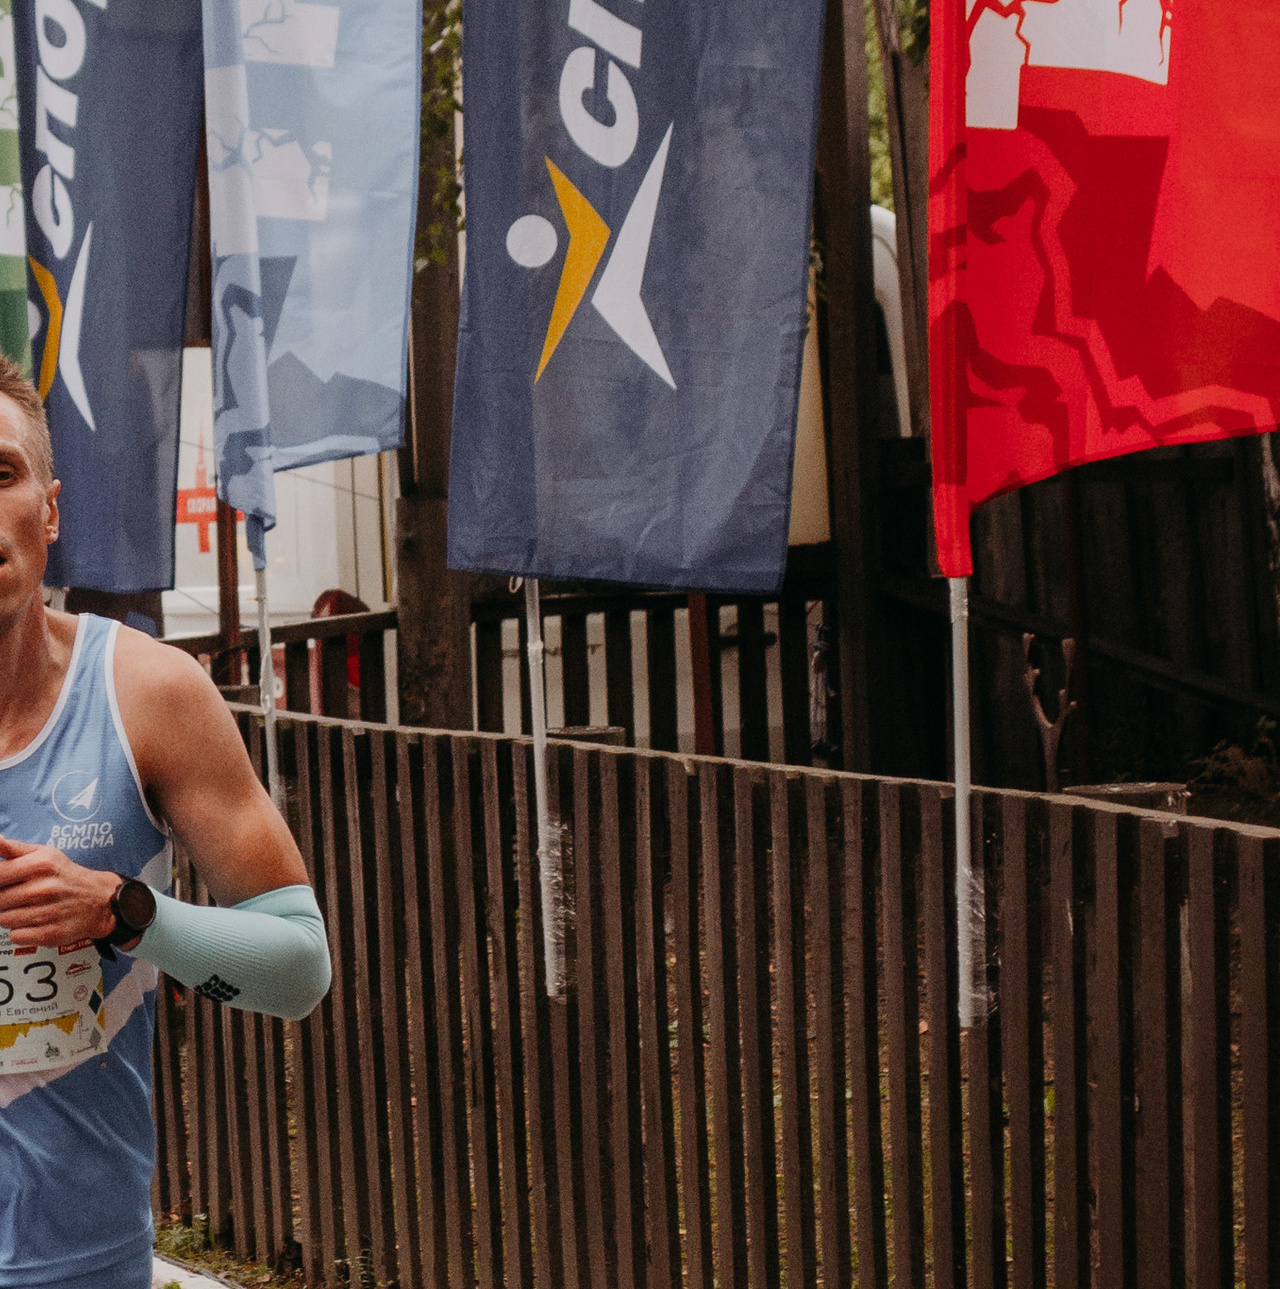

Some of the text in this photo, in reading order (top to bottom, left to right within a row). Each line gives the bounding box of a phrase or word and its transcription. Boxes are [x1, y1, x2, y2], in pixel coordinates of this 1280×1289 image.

[50, 821, 112, 838] ВСМПО
[46, 833, 114, 850] АВИСМА
[6, 1002, 59, 1017] Евгений
